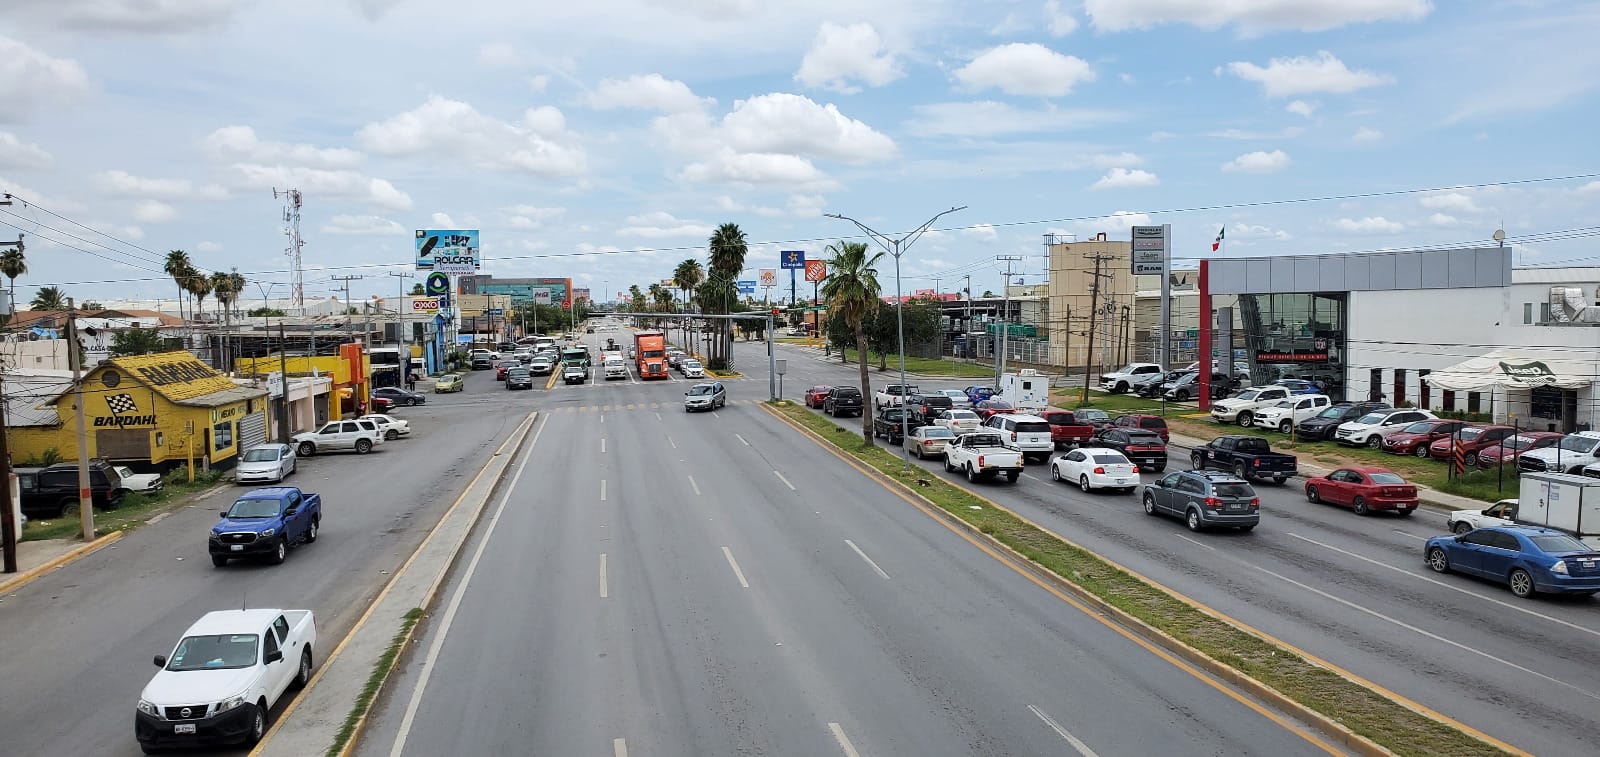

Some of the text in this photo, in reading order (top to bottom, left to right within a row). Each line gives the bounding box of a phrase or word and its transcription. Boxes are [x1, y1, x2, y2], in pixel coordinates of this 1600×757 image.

[413, 301, 438, 309] OXXO
[137, 360, 219, 386] BARDAHL
[1507, 366, 1542, 376] Jeep
[93, 415, 158, 429] BARDAHL
